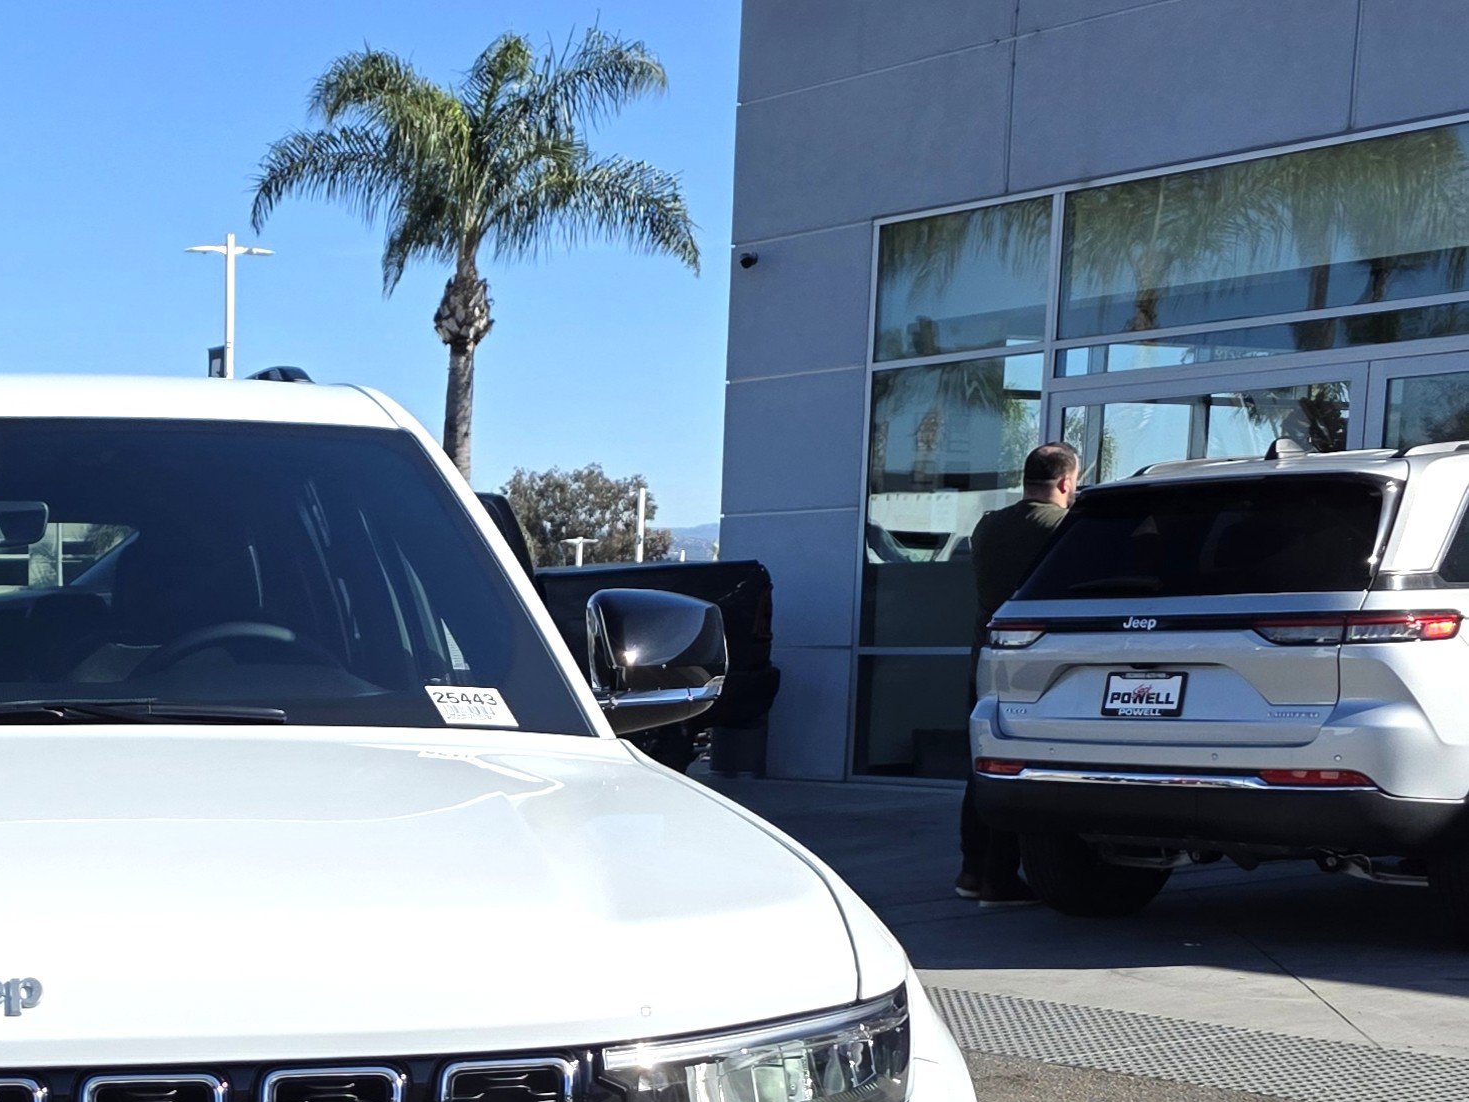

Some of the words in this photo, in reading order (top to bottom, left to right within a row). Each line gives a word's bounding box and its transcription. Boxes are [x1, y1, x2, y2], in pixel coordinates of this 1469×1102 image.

[1122, 617, 1157, 630] Jeep
[433, 691, 497, 706] 25443
[1110, 692, 1175, 704] POWELL
[1118, 708, 1162, 716] POWELL
